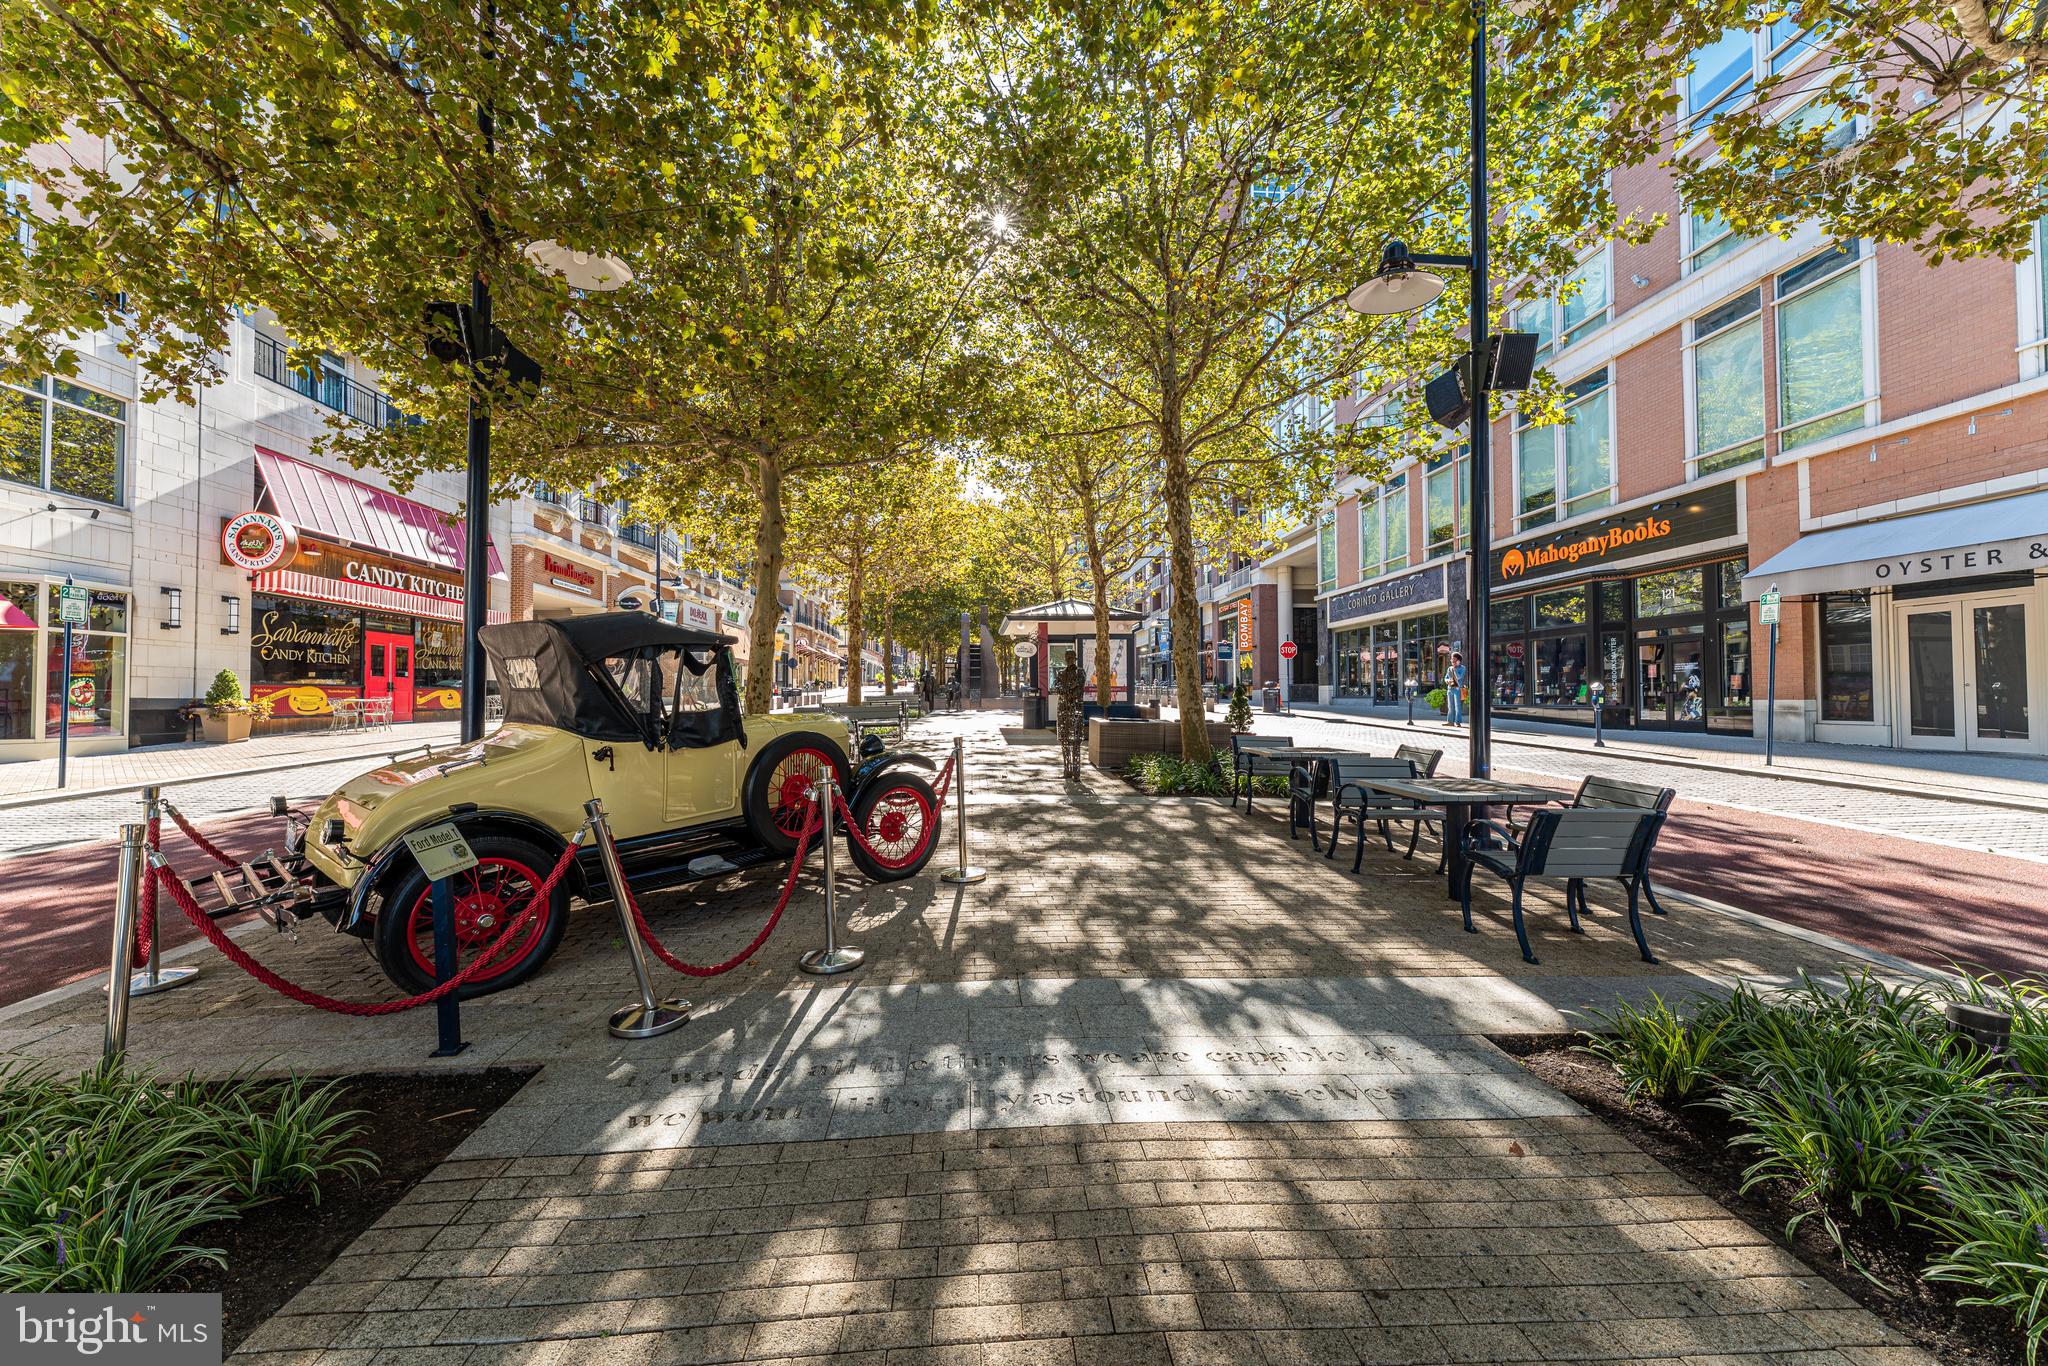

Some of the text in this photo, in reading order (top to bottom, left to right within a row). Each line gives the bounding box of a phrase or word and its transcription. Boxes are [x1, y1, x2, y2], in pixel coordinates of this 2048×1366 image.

[228, 515, 282, 541] SAVANNAH'S
[229, 543, 281, 567] CANDY KITCHEN
[1526, 516, 1671, 569] MahoganyBooks
[1875, 542, 2048, 578] OYSTER &
[62, 587, 69, 597] 2
[346, 561, 464, 600] CANDY KITCHE
[1348, 583, 1415, 610] CORINTO GALLERY
[1661, 588, 1675, 600] 121
[250, 611, 360, 653] Savannah's
[1240, 602, 1248, 648] BOMBAY
[261, 645, 350, 664] CANDY KITCHEN
[415, 631, 463, 659] Savann
[1280, 645, 1296, 655] STOP
[411, 828, 459, 851] Ford Model T
[1072, 1052, 1122, 1064] we
[1132, 1052, 1193, 1064] are
[1205, 1046, 1349, 1066] capable
[628, 1112, 687, 1128] we
[1032, 1083, 1198, 1106] astound
[1212, 1083, 1408, 1102] ourselves
